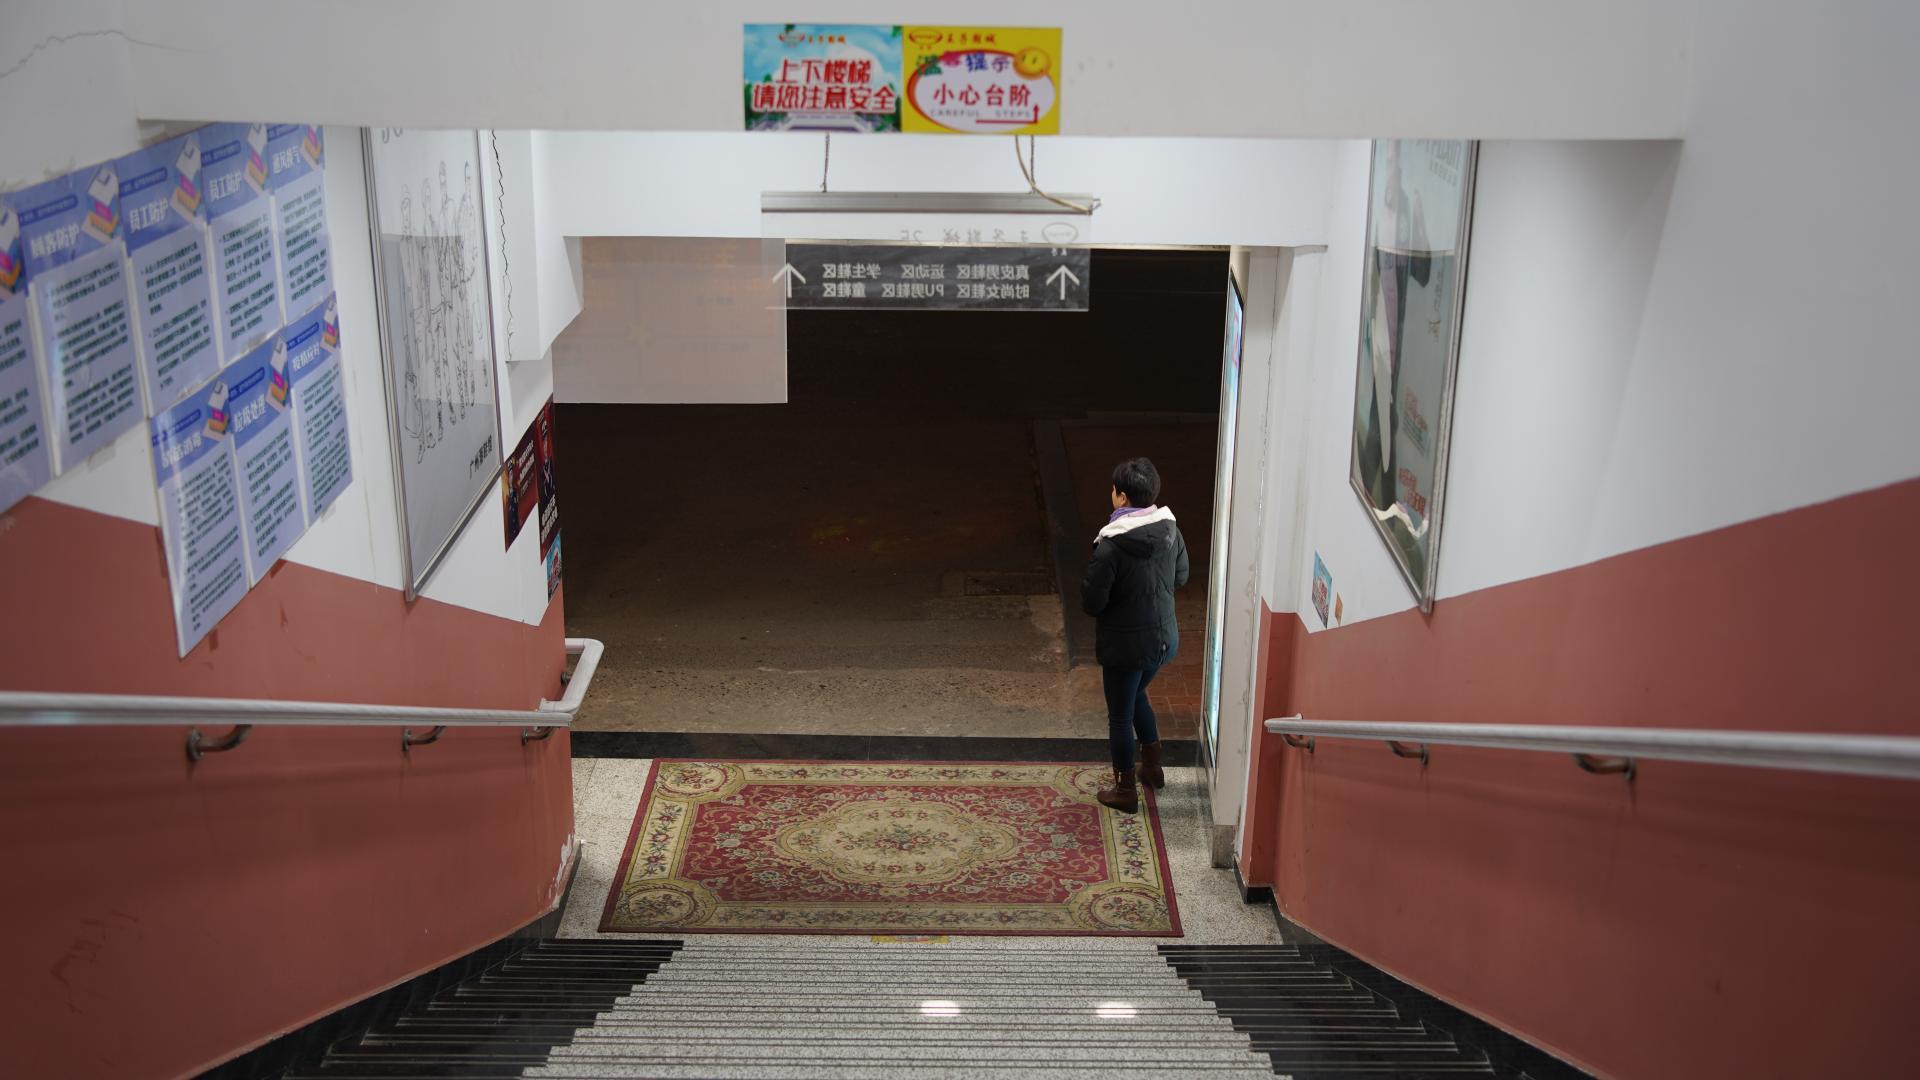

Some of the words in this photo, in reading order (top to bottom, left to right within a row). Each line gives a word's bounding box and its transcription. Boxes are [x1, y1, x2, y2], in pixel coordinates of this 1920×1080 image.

[776, 58, 872, 84] 上下楼梯
[753, 84, 896, 110] 请您注意安全
[933, 82, 1032, 107] 小心台阶
[995, 109, 1032, 118] STEPS
